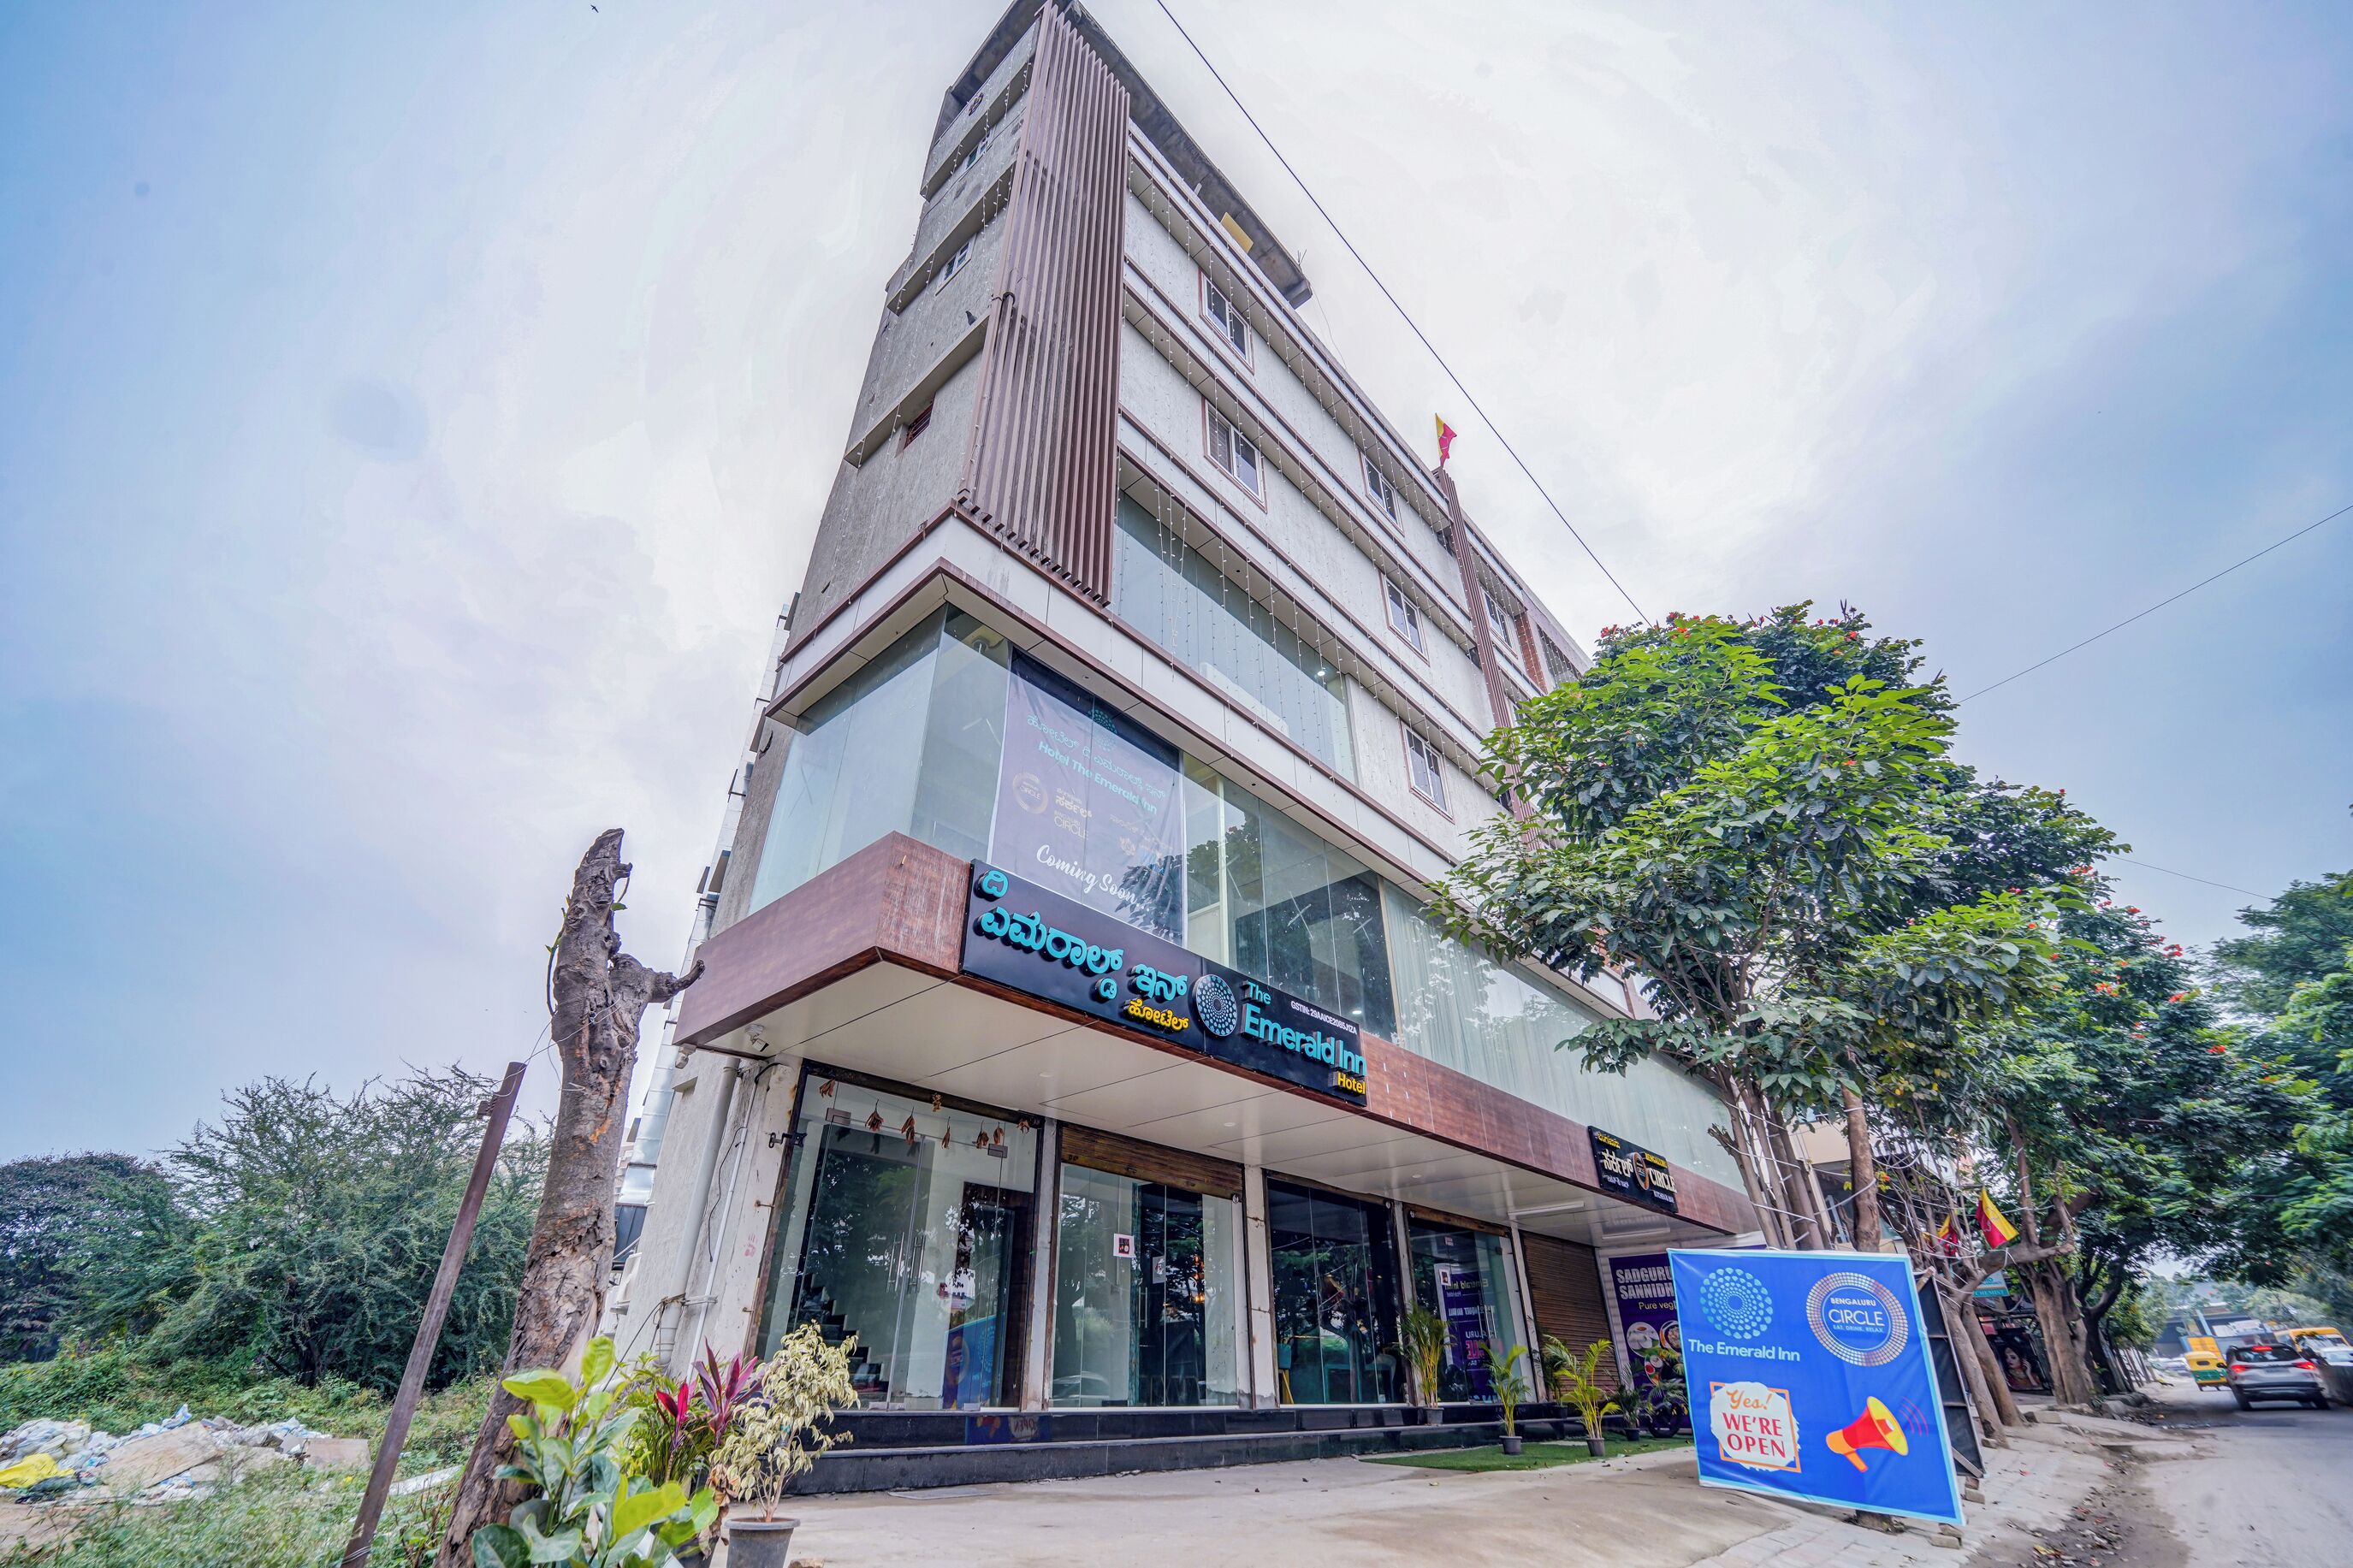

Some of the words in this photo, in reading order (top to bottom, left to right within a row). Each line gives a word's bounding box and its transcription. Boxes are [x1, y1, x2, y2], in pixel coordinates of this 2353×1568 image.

[1038, 741, 1070, 766] Hotel
[1072, 759, 1093, 778] The
[1094, 772, 1140, 806] Emerald
[1036, 843, 1098, 894] Coming
[982, 869, 1009, 898] ದಿ
[1135, 963, 1188, 1002] ಇನ್
[1247, 980, 1271, 1005] The
[1128, 997, 1190, 1032] ಹೋಟೆಲ್
[1290, 1000, 1310, 1016] GSTIN:
[1244, 1003, 1336, 1065] Emerald
[1338, 1039, 1367, 1077] Inn
[1337, 1071, 1366, 1095] Hotel
[1648, 1167, 1677, 1193] CIRCLE
[1638, 1301, 1657, 1311] Pure
[1829, 1297, 1877, 1307] BENGALURU
[1828, 1308, 1885, 1327] CIRCLE
[1687, 1339, 1715, 1353] The
[1716, 1341, 1776, 1359] Emerald
[1778, 1347, 1801, 1362] Inn
[1726, 1389, 1773, 1411] Yes!
[1722, 1411, 1783, 1437] WE'RE
[1727, 1433, 1787, 1459] OPEN
